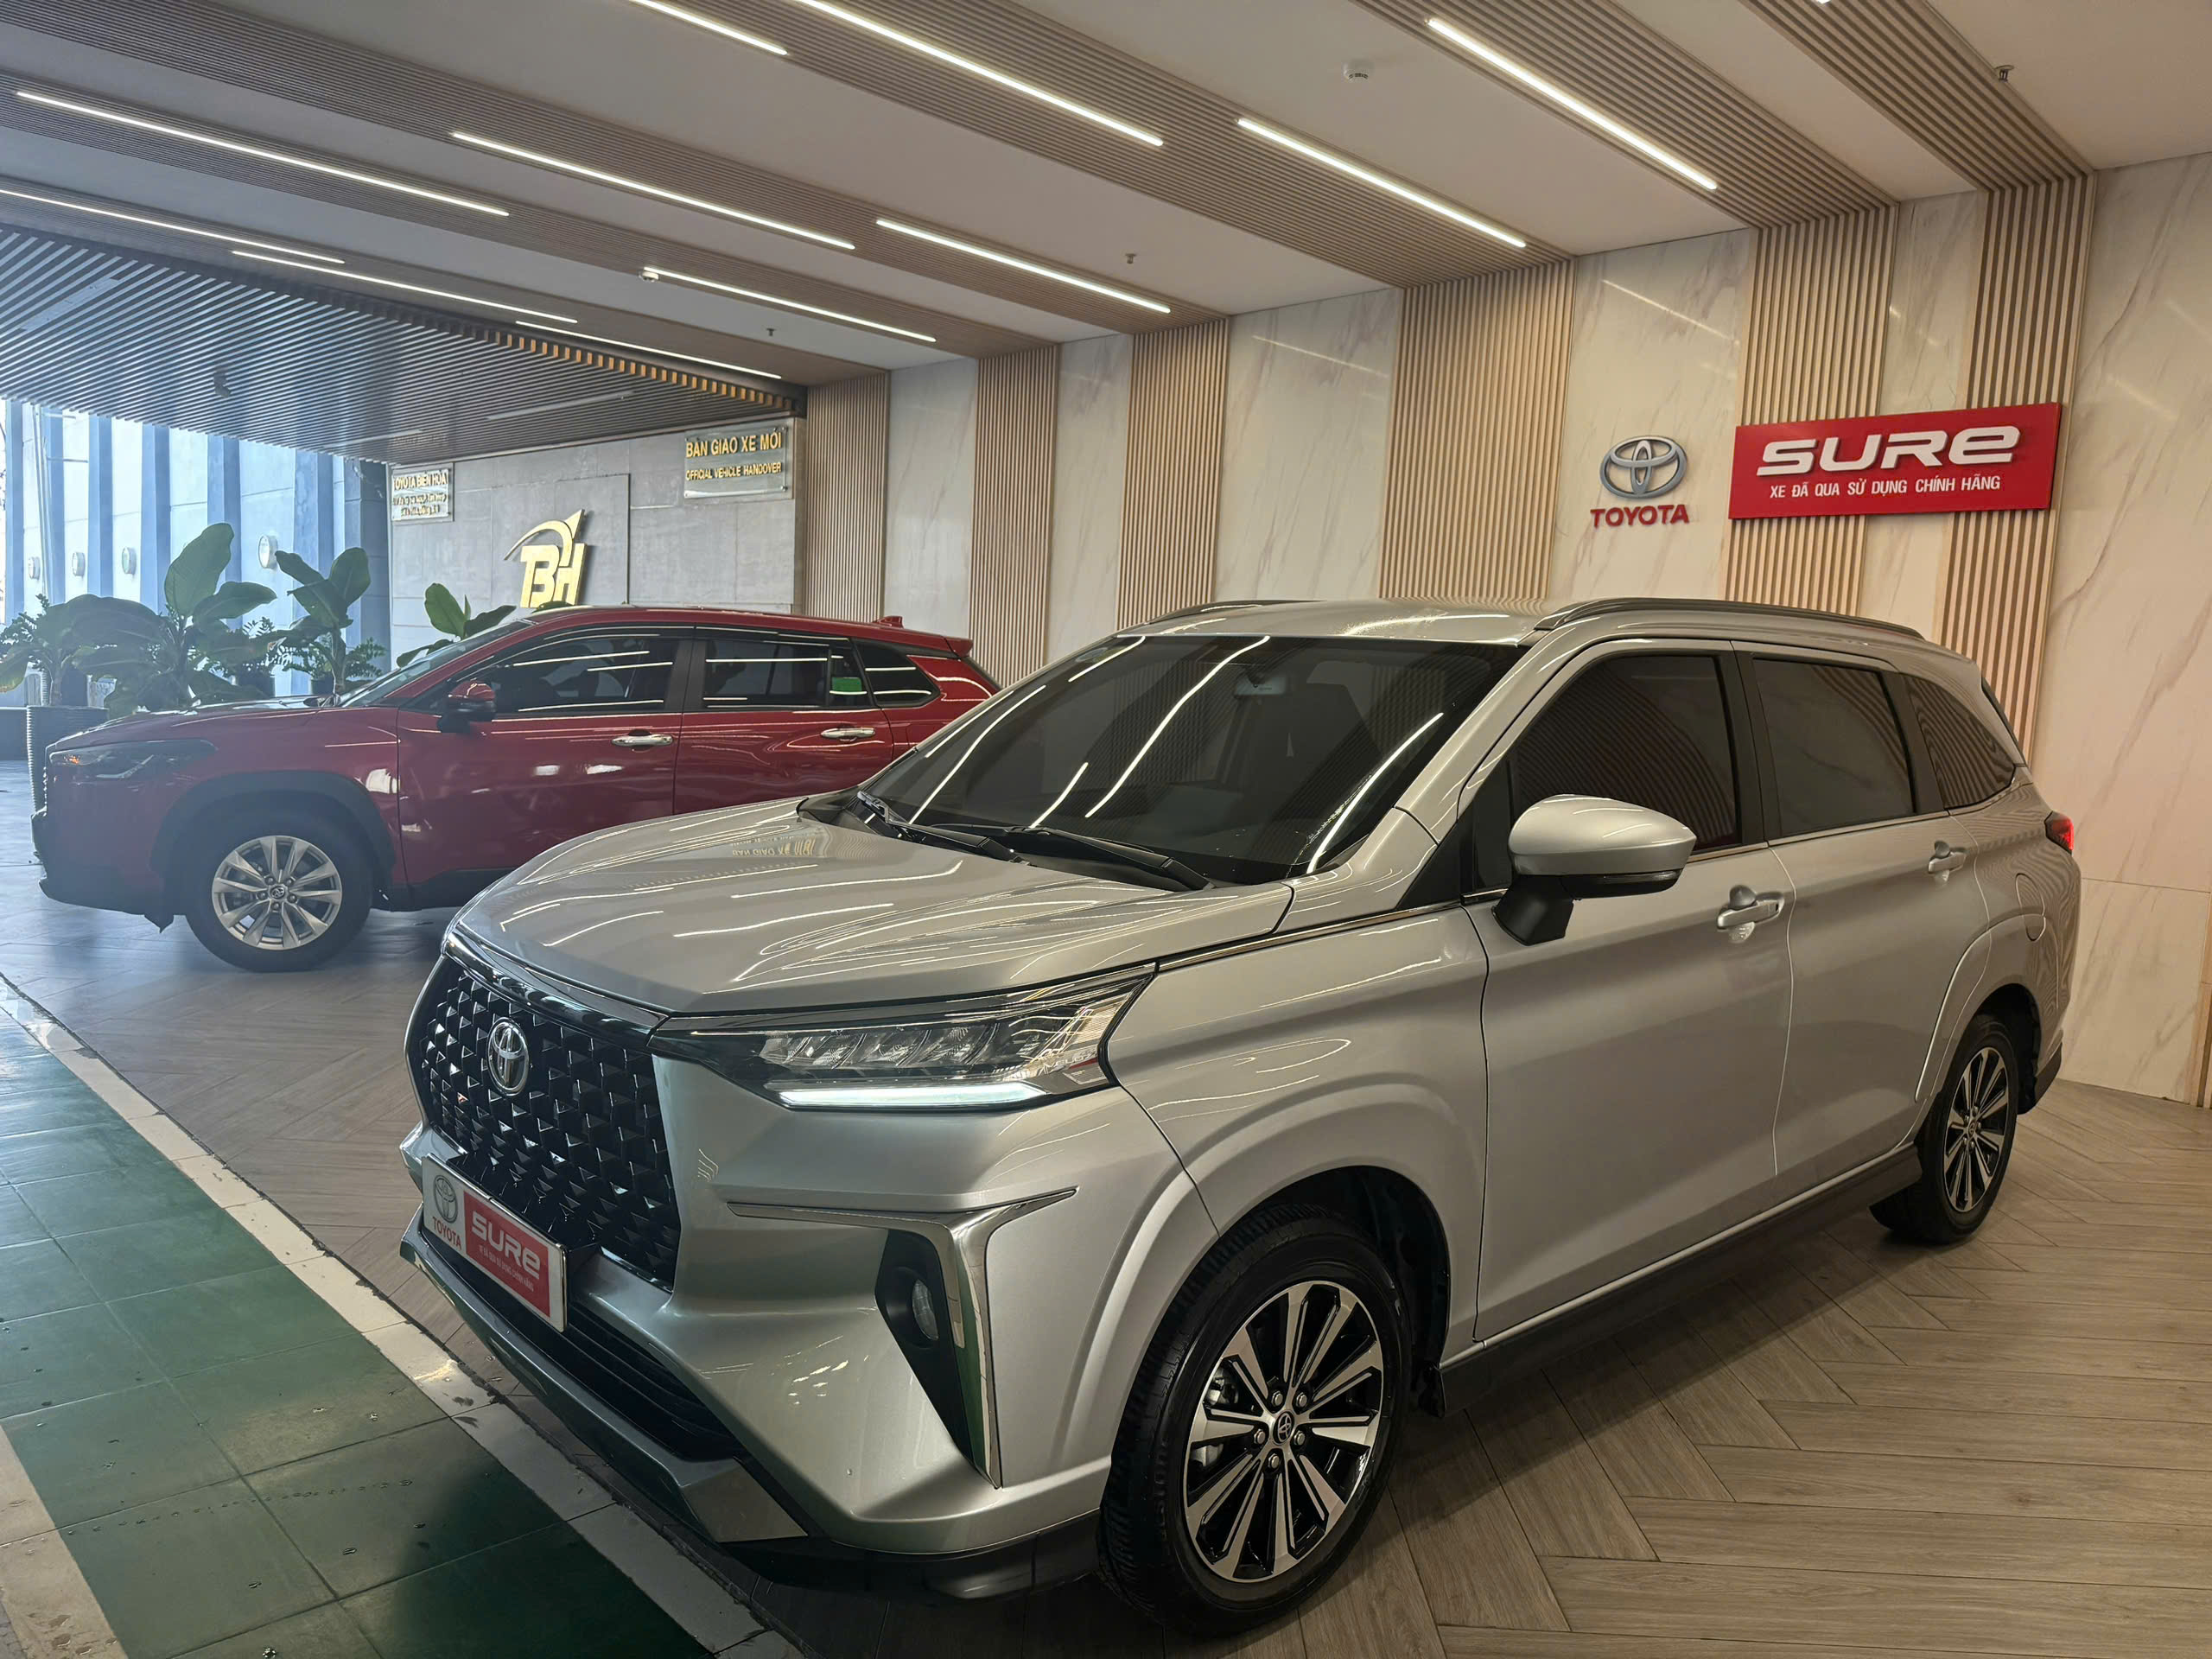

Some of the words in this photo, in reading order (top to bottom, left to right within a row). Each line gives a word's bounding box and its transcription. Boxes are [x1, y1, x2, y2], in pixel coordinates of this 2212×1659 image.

[711, 436, 738, 455] GIAO
[741, 435, 757, 453] XE
[685, 468, 713, 481] OFFICIAL
[714, 465, 741, 479] VEHICLE
[743, 461, 782, 476] HANDOVER
[1770, 485, 1786, 499] XE
[1791, 480, 1809, 498] ĐÃ
[1815, 482, 1840, 498] QUA
[1847, 478, 1867, 496] SỬ
[1872, 480, 1907, 497] DỤNG
[1915, 475, 1955, 493] CHÍNH
[1961, 474, 2001, 491] HÃNG
[1590, 503, 1690, 529] TOYOTA
[432, 1216, 462, 1250] TOYOTA
